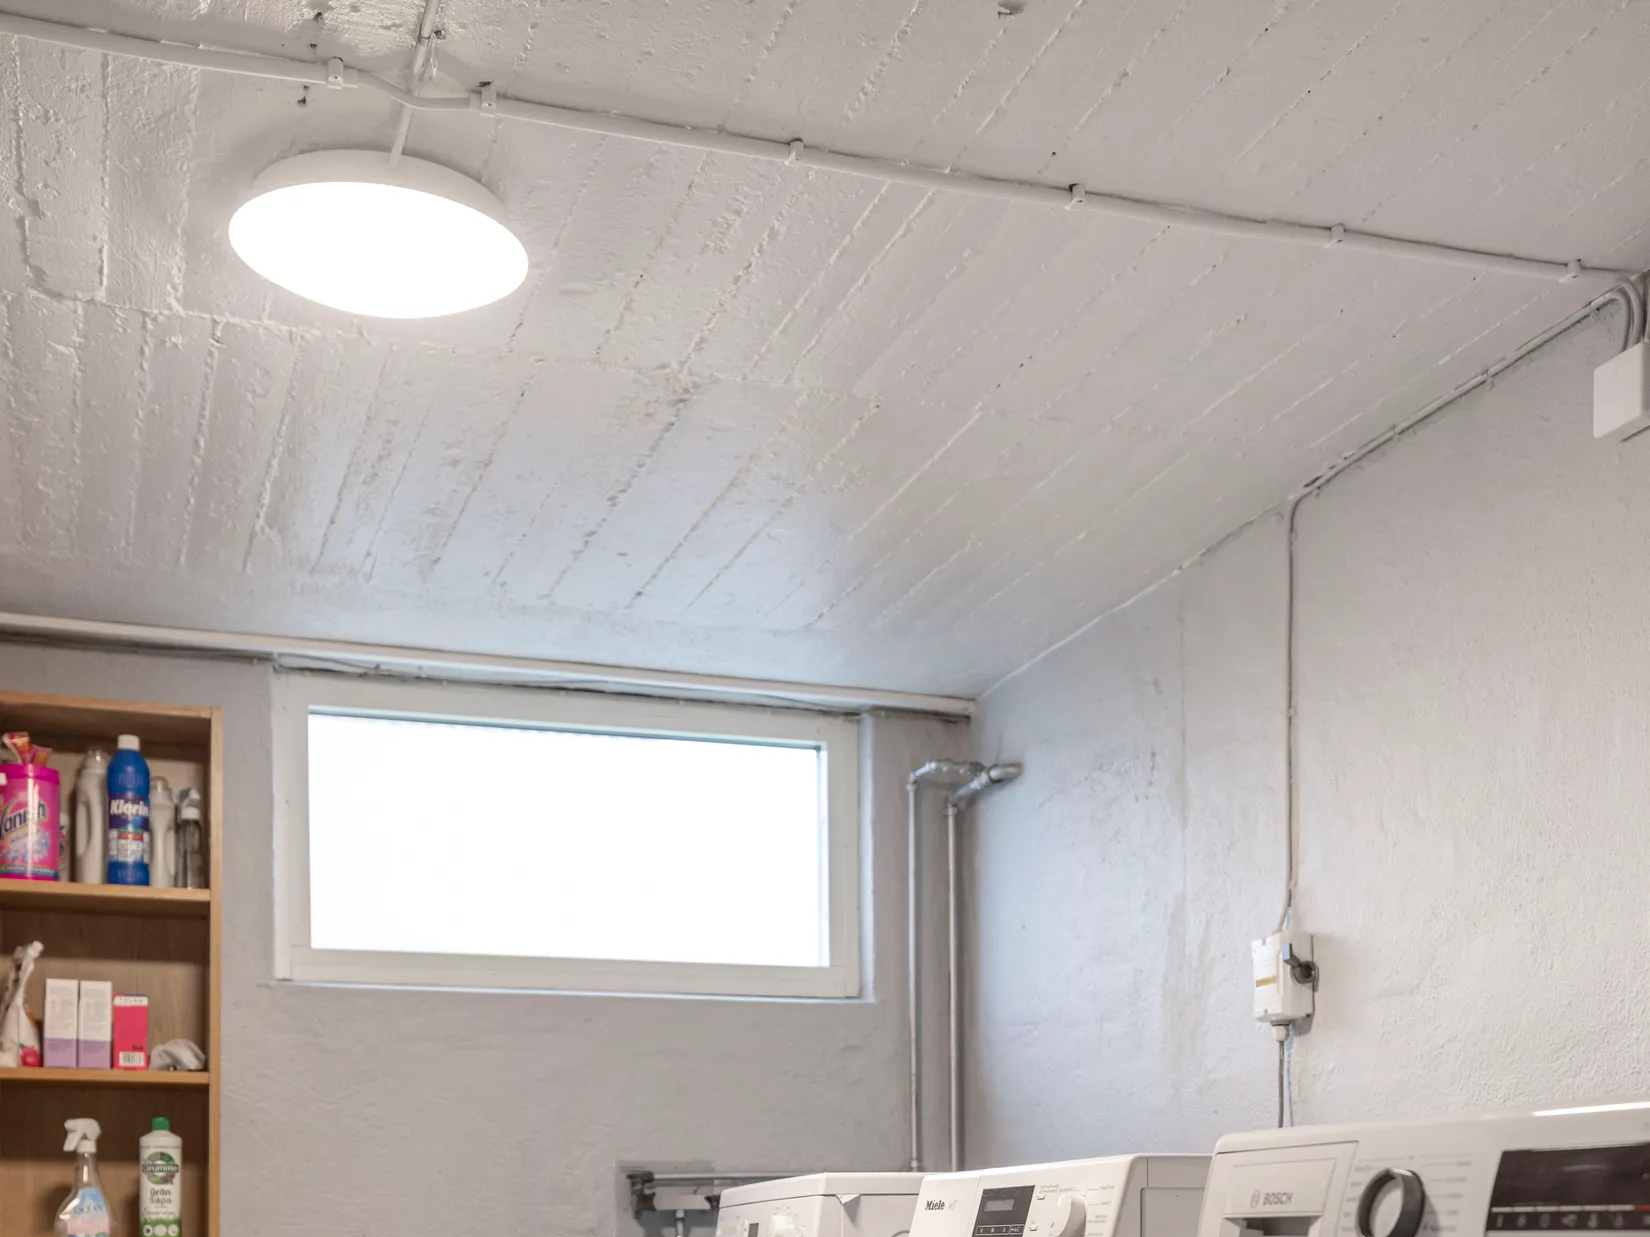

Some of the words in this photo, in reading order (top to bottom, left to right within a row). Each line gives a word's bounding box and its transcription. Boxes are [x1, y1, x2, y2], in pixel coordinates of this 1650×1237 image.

[110, 799, 149, 816] Klorin
[0, 799, 47, 839] anih
[925, 1200, 945, 1211] Miele
[1263, 1191, 1294, 1206] BOSCH
